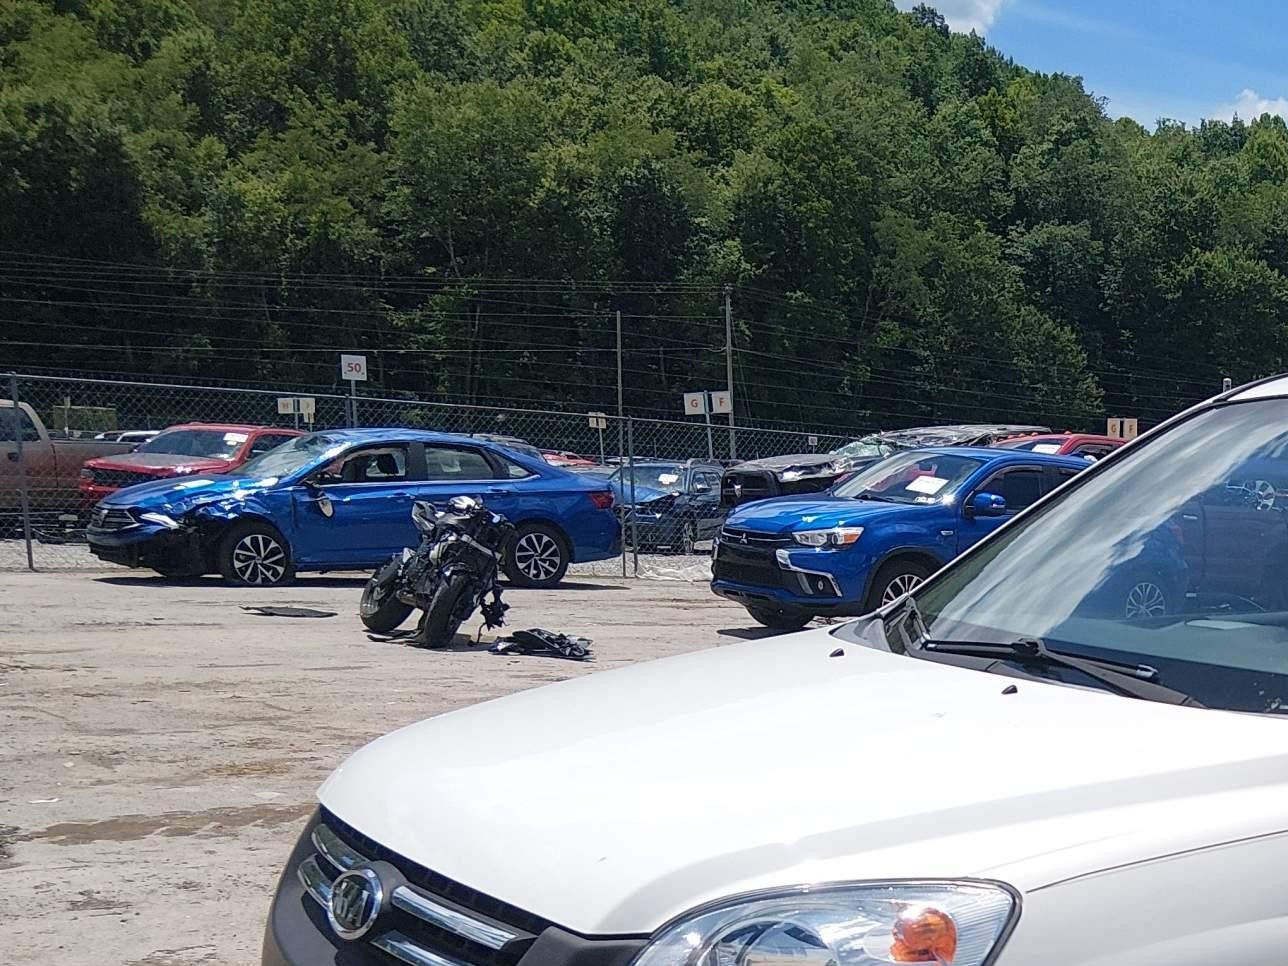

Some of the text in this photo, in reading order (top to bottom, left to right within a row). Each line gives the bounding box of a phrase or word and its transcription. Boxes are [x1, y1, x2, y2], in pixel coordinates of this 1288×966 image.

[347, 363, 362, 374] 50
[690, 399, 698, 408] G
[719, 398, 725, 407] F
